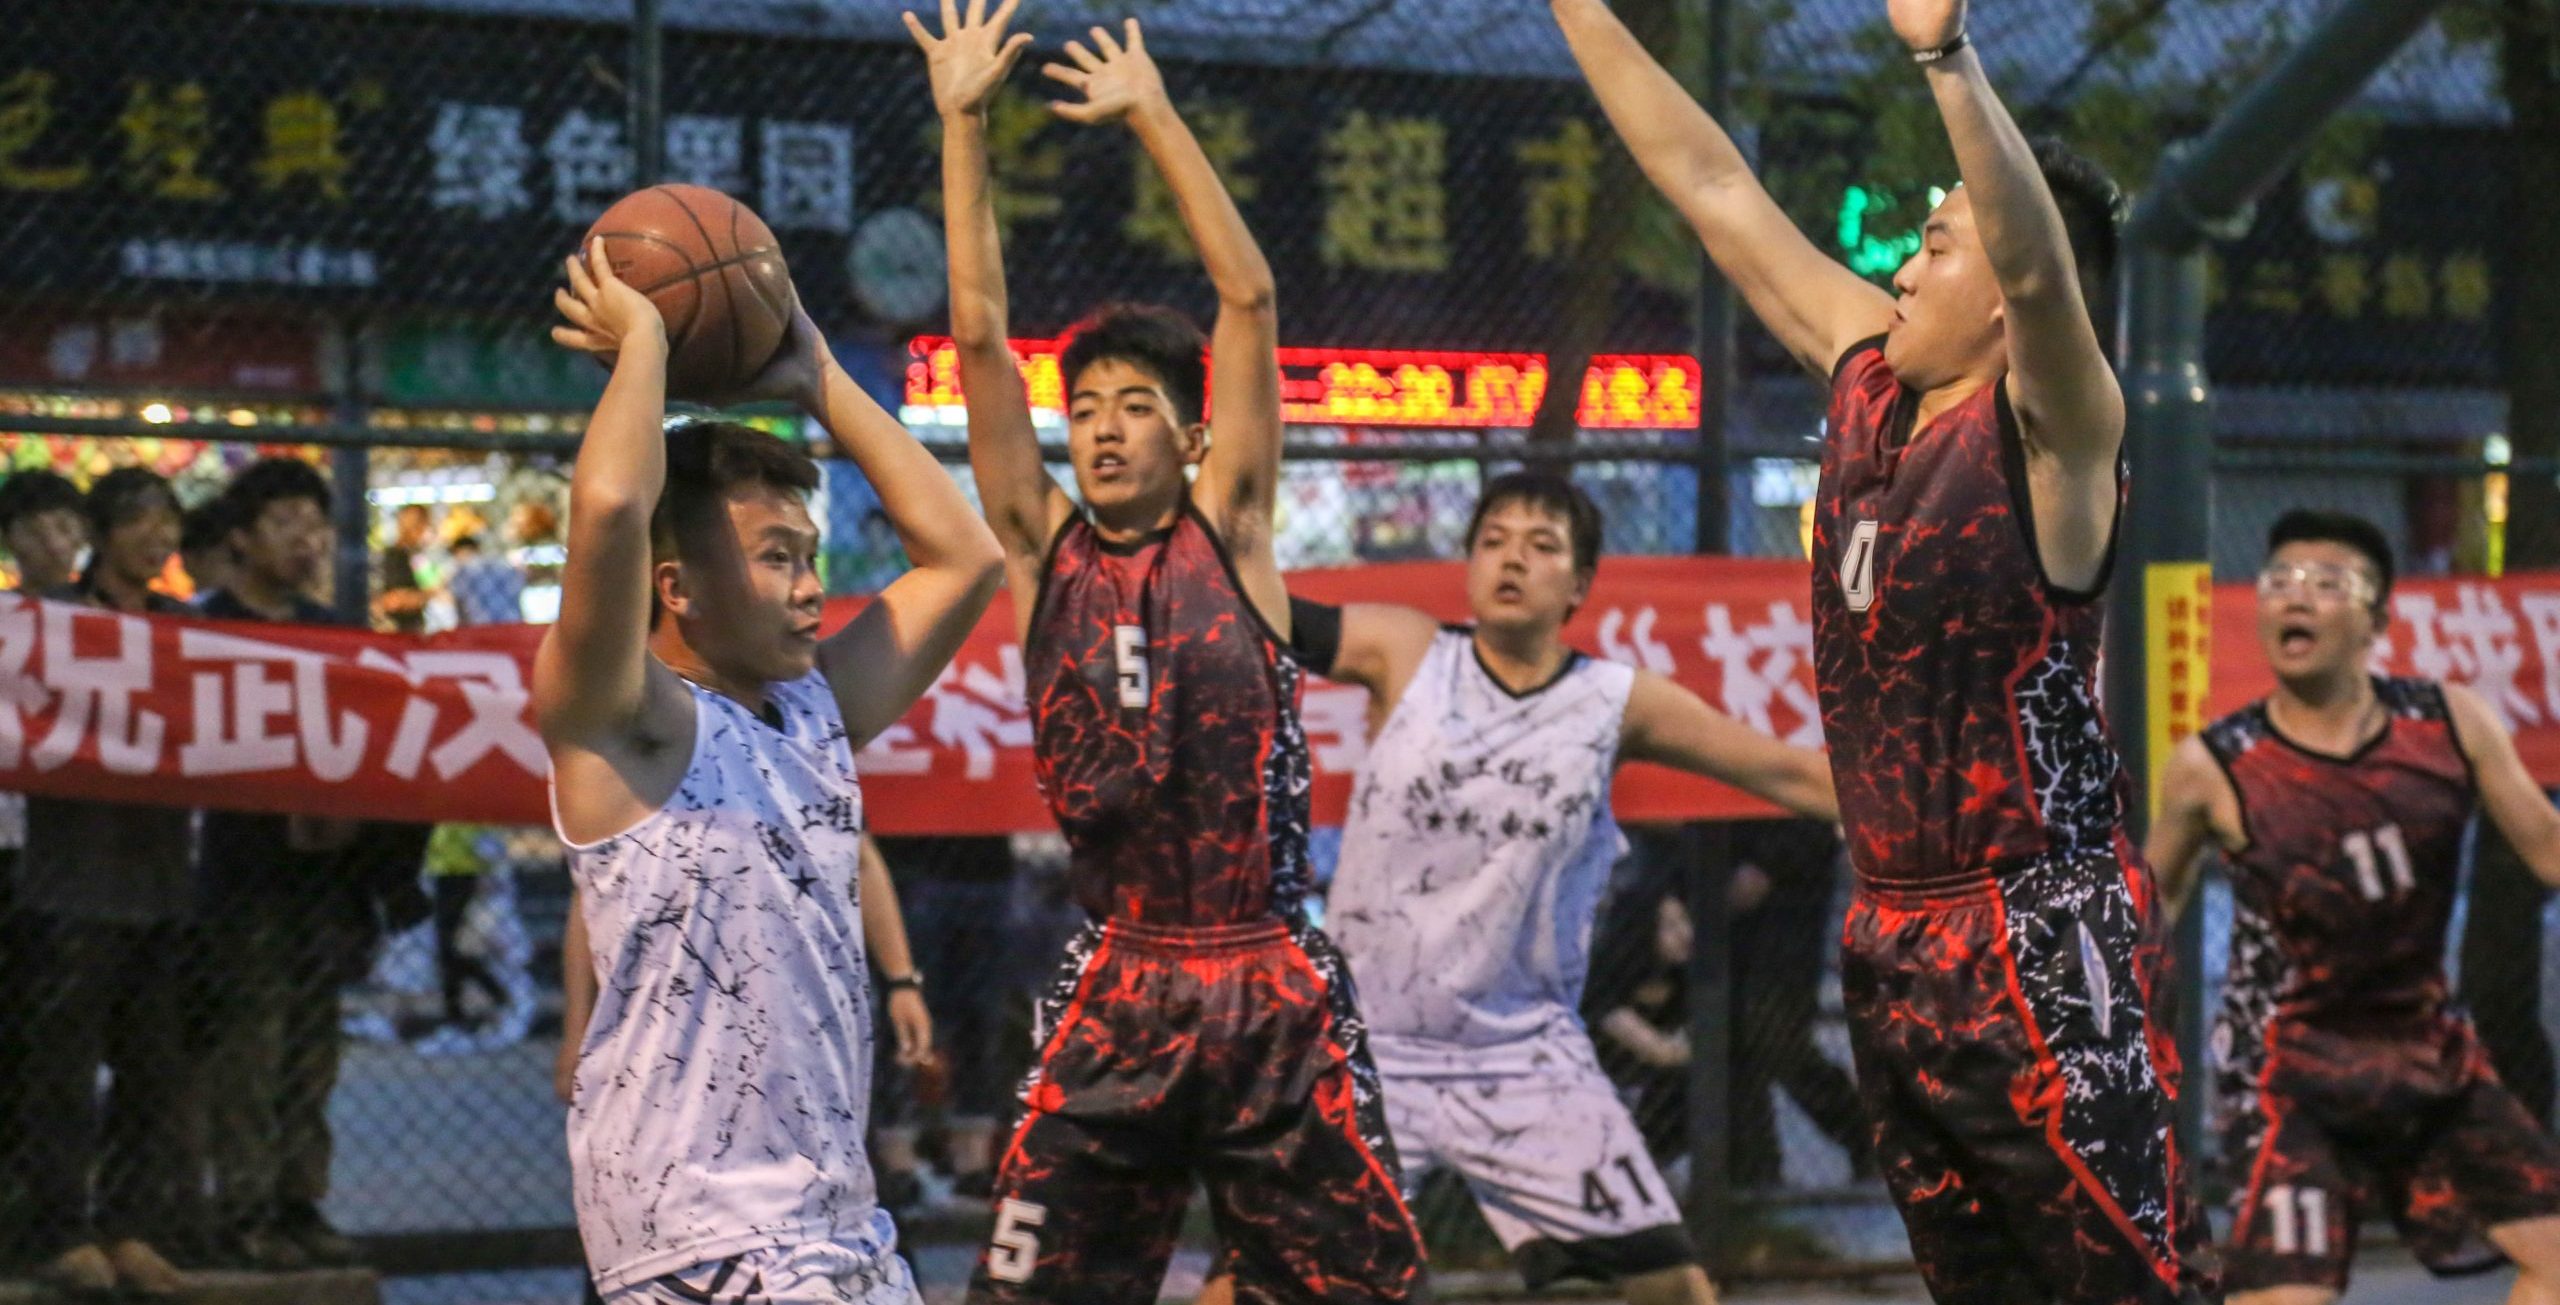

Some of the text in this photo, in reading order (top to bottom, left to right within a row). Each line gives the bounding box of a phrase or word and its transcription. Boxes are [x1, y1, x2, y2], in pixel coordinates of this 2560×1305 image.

[1840, 520, 1878, 612] 0
[1114, 625, 1150, 708] 5
[2342, 824, 2416, 900] 11
[1581, 1155, 1656, 1222] 41
[2266, 1184, 2328, 1256] 11
[987, 1197, 1047, 1284] 5
